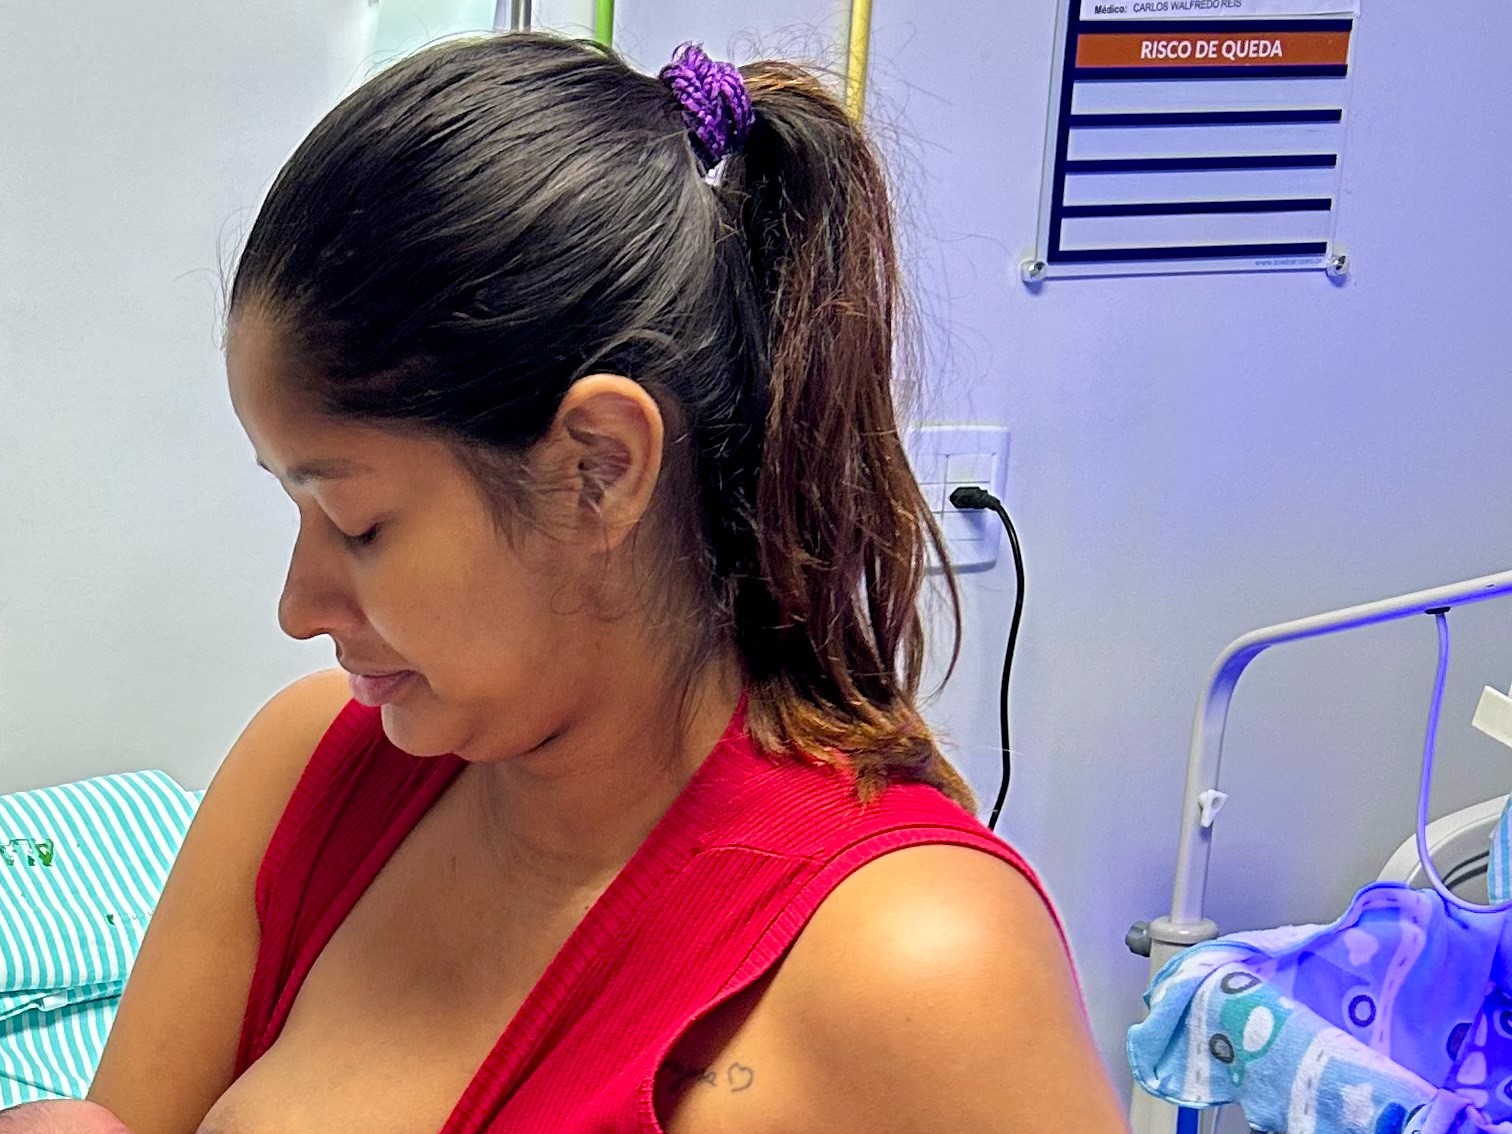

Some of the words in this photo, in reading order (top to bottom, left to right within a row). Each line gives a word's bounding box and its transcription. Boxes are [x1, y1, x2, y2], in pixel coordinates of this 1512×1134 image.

[1133, 2, 1168, 13] CARLOS
[1171, 0, 1219, 10] WALFREDO
[1221, 0, 1242, 8] REIS
[1140, 41, 1192, 59] RISCO
[1195, 40, 1218, 59] DE
[1222, 40, 1283, 61] QUEDA
